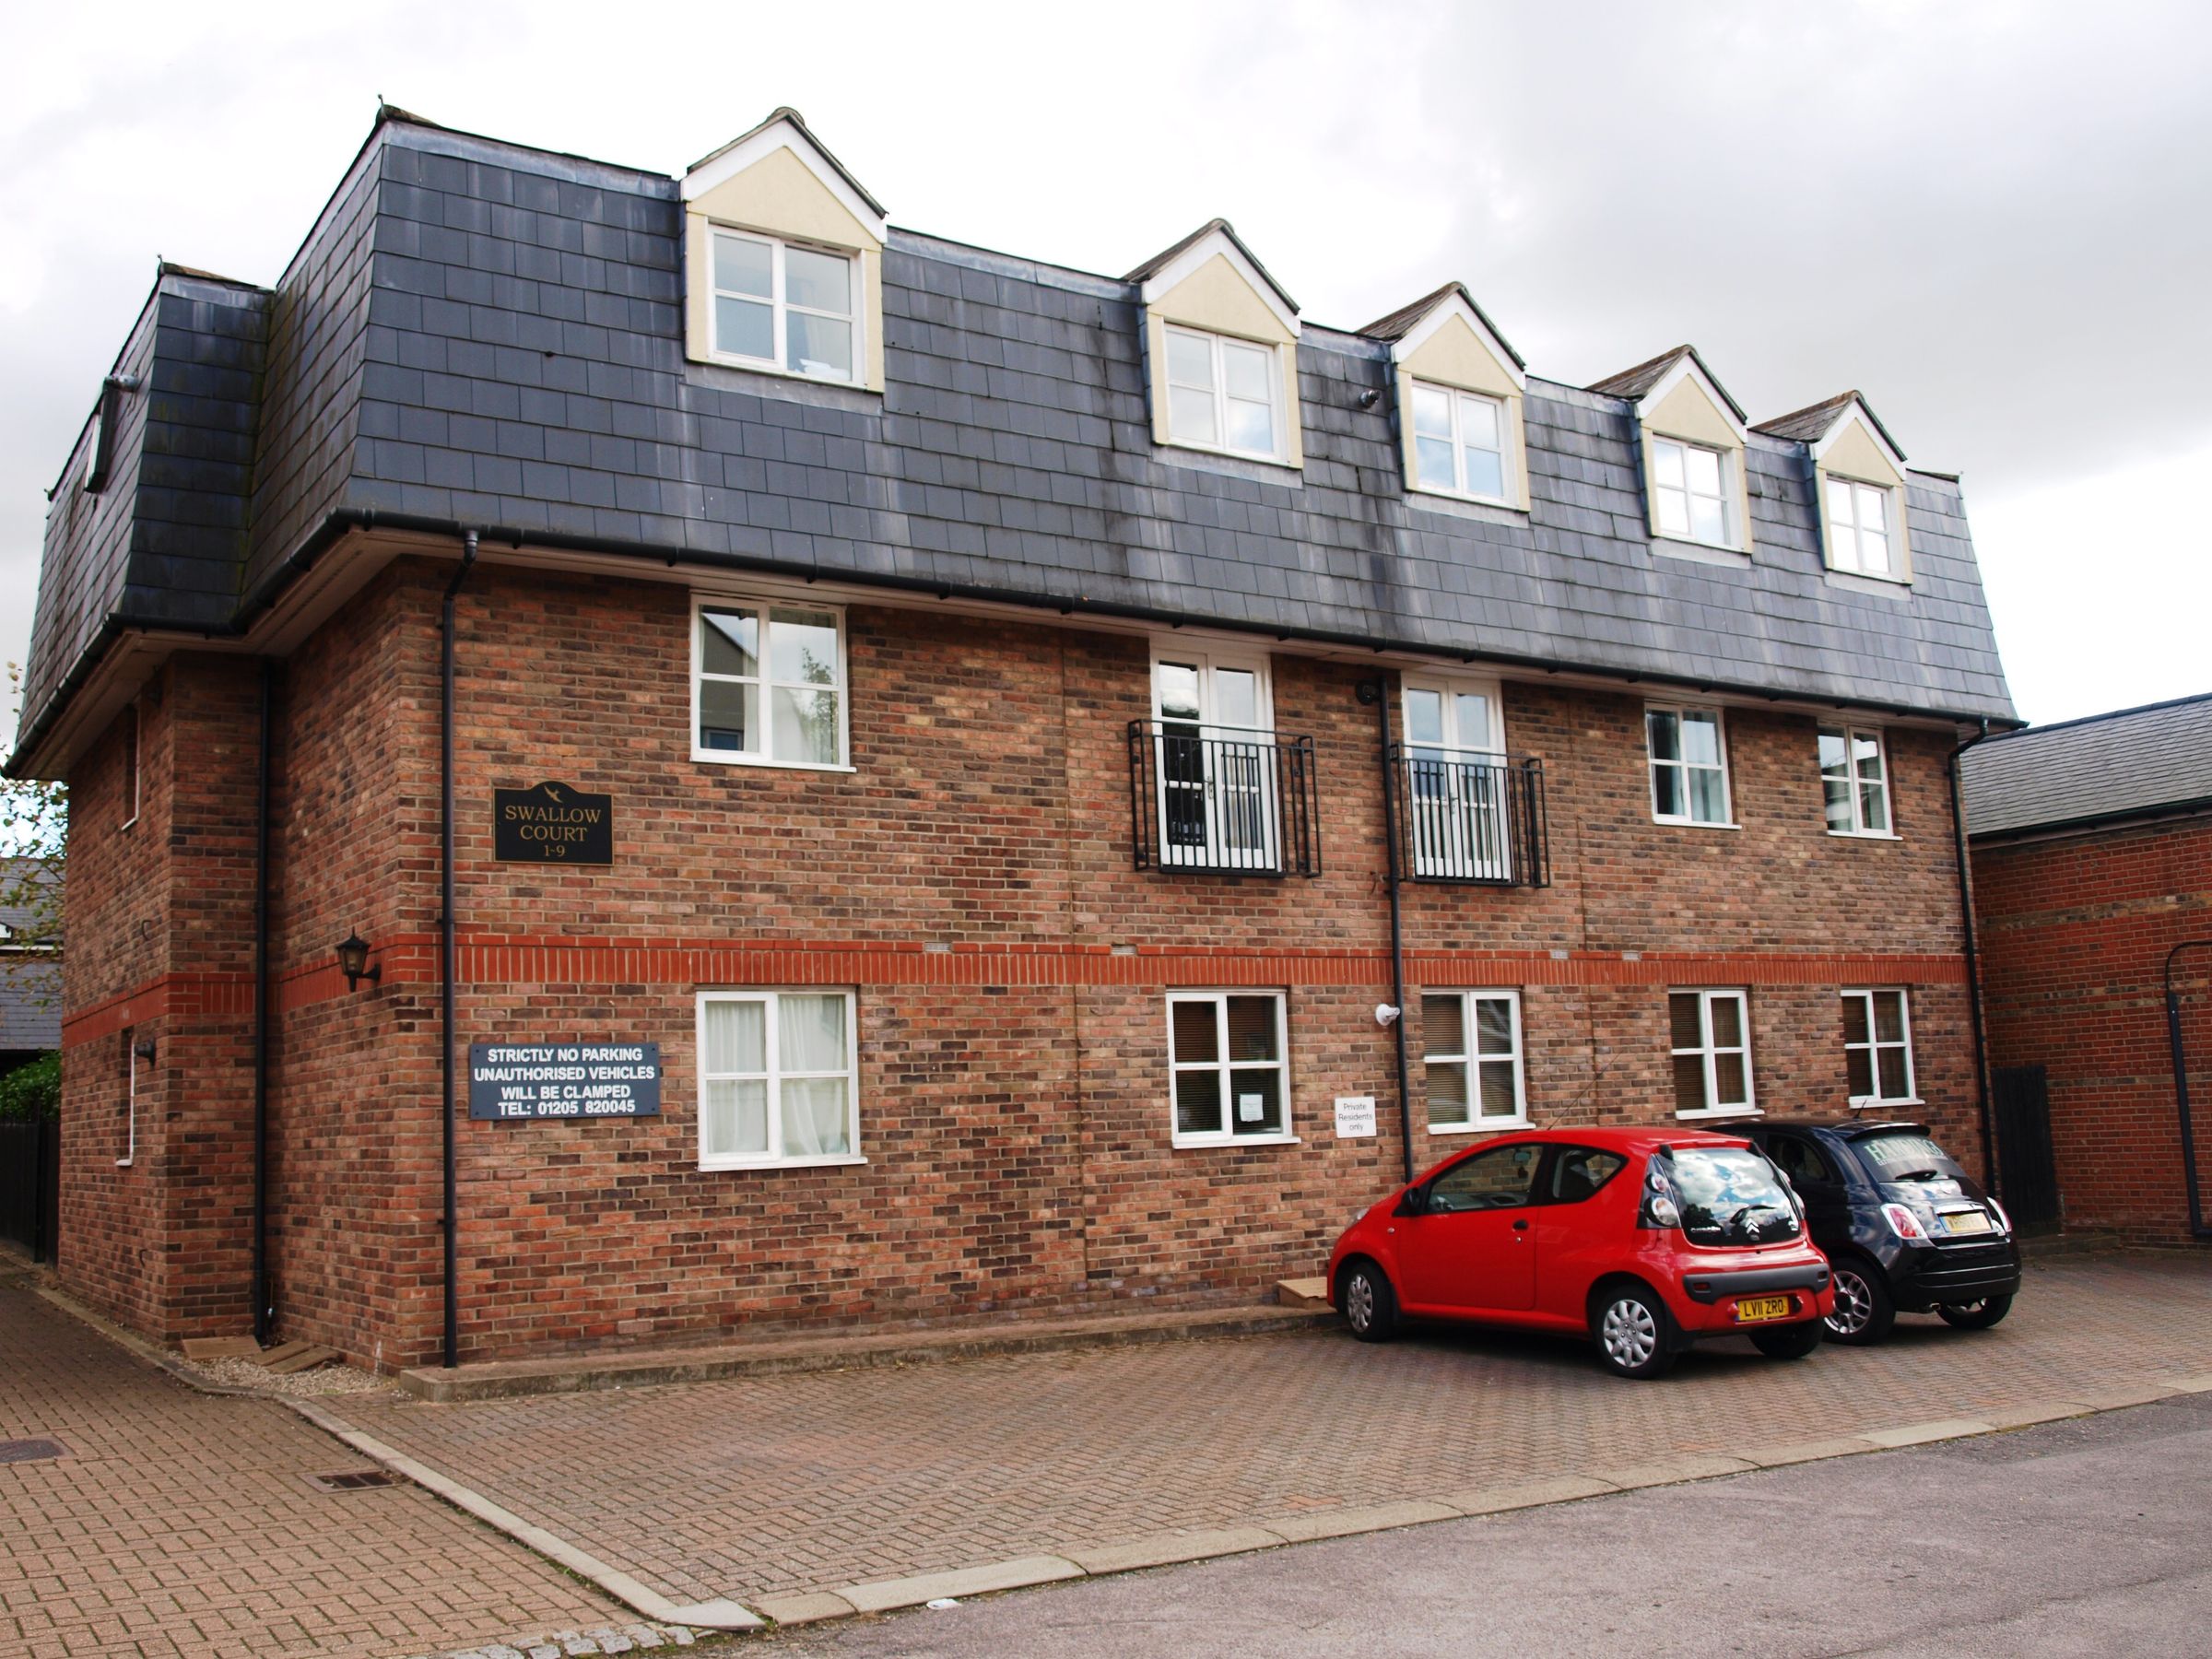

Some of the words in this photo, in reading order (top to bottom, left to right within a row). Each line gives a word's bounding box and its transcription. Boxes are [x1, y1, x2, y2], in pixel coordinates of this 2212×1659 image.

[505, 805, 601, 823] SWALLOW
[520, 825, 588, 841] COURT
[488, 1048, 554, 1063] STRICTLY
[557, 1048, 579, 1062] NO
[582, 1048, 643, 1061] PARKING
[474, 1066, 585, 1081] UNAUTHORISED
[588, 1065, 655, 1080] VEHICLES
[500, 1086, 536, 1100] WILL
[540, 1086, 559, 1100] BE
[563, 1085, 631, 1099] CLAMPED
[498, 1101, 532, 1116] TEL:
[537, 1100, 579, 1115] 01205
[585, 1100, 636, 1113] 820045
[1343, 1102, 1368, 1111] Private
[1348, 1123, 1364, 1132] only
